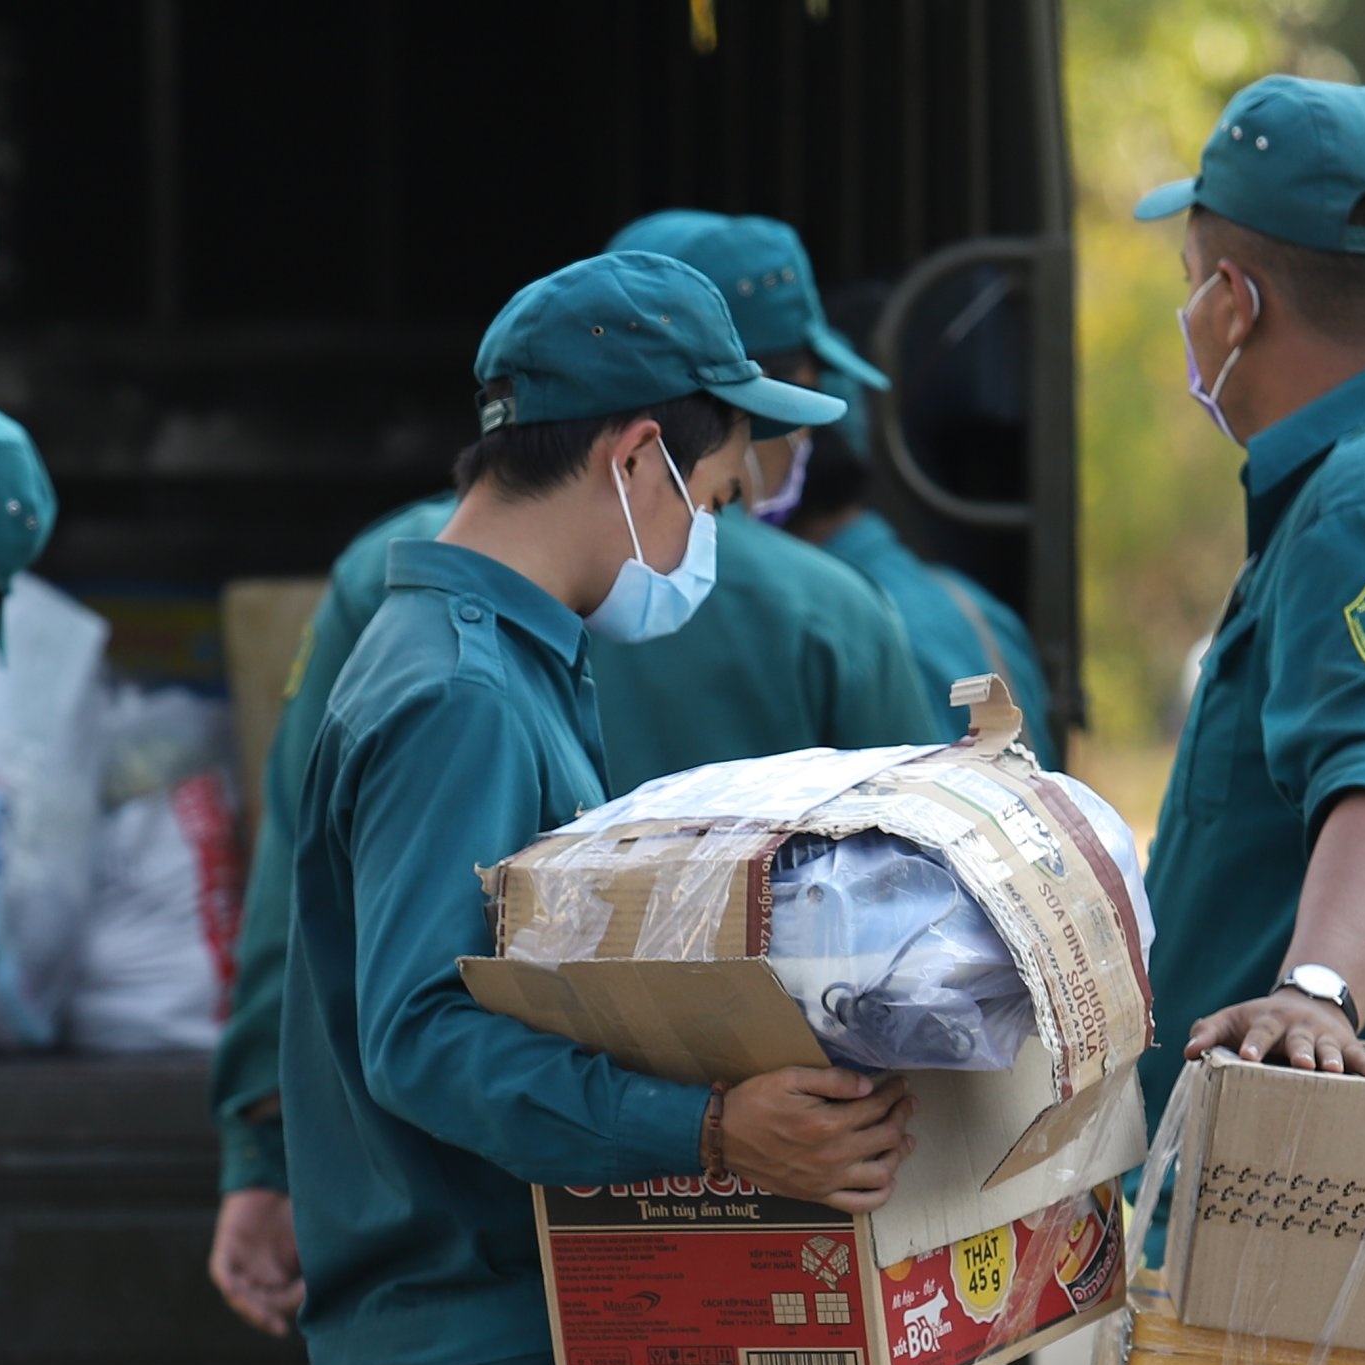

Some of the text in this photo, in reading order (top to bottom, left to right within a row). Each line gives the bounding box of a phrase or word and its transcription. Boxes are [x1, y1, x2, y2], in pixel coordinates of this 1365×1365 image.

[1062, 924, 1088, 976] DINH
[1046, 946, 1075, 1015] VITAMIN
[964, 1236, 999, 1268] THẬT
[969, 1269, 1001, 1294] 45 g
[906, 1318, 933, 1359] Bò
